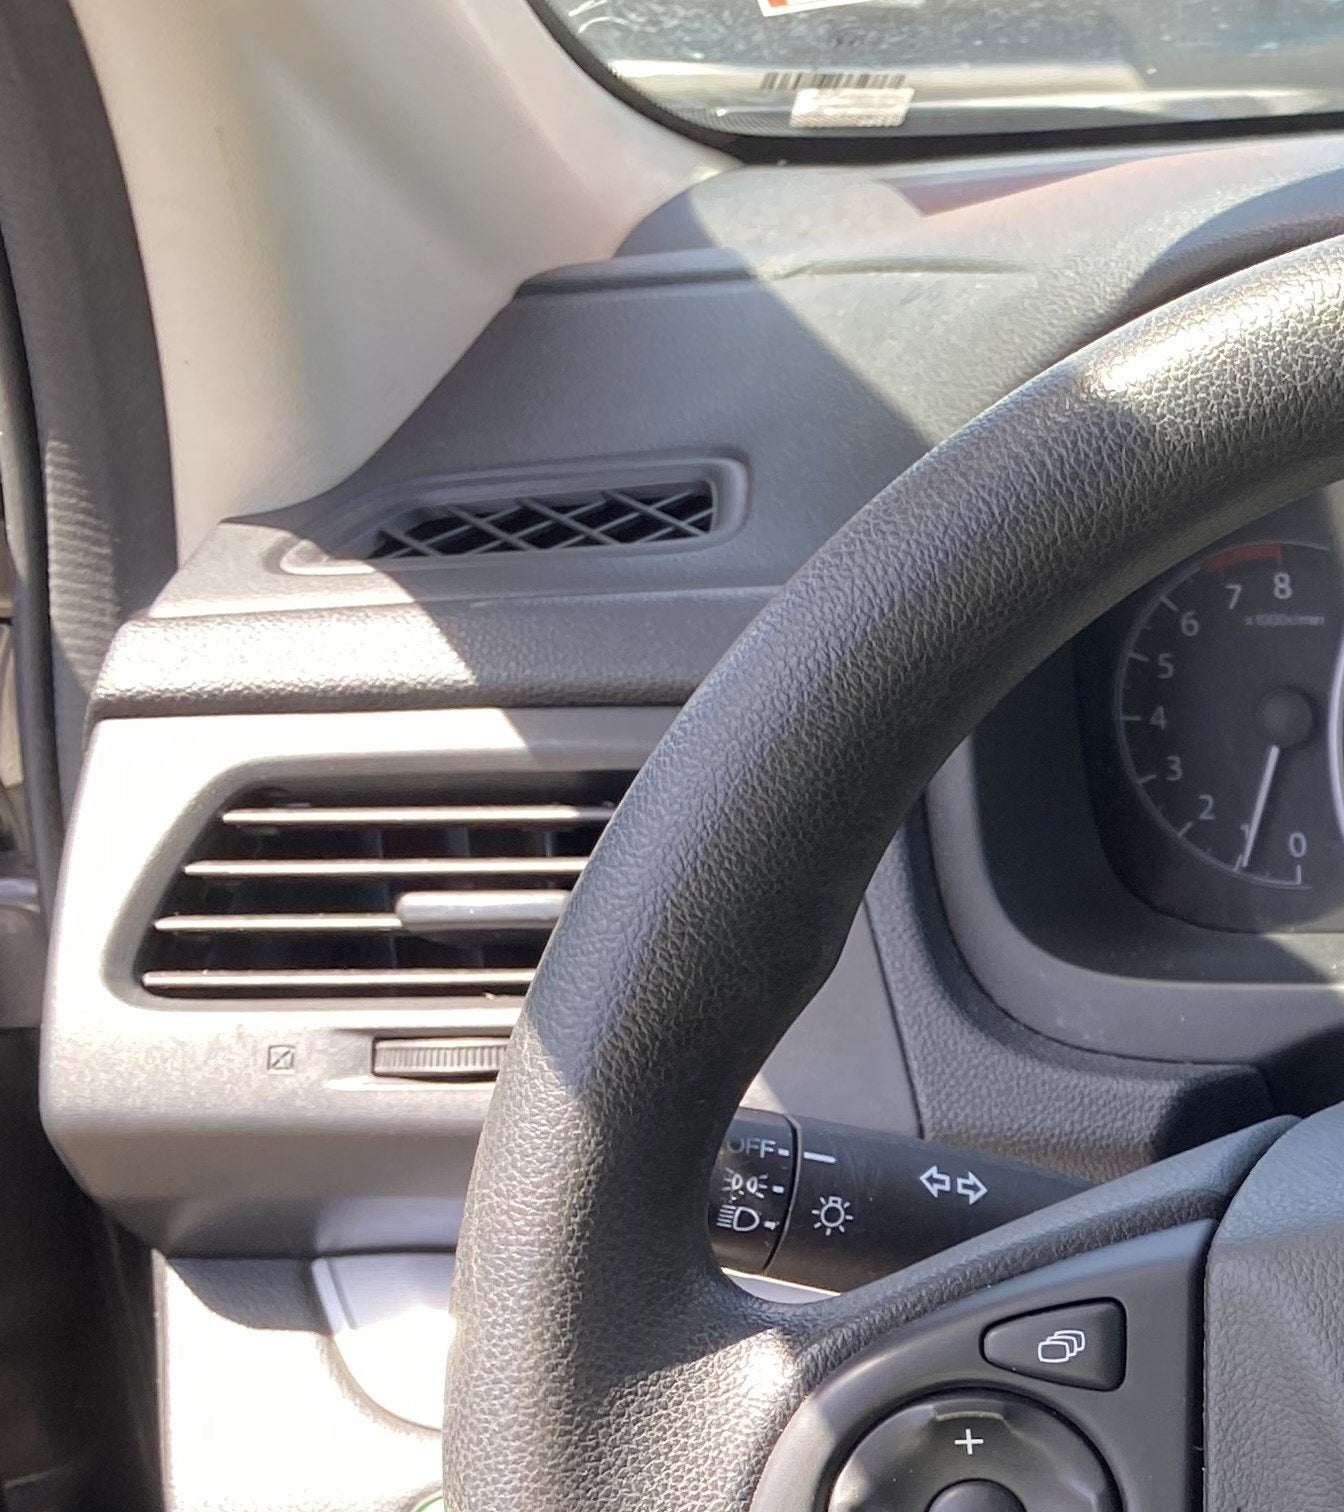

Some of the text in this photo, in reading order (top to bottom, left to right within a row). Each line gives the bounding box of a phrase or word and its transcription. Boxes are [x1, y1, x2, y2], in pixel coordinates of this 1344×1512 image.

[1225, 584, 1242, 610] 7
[1273, 572, 1292, 600] 8
[1180, 611, 1200, 636] 6
[1157, 653, 1174, 679] 5
[1150, 706, 1167, 730] 4
[1166, 755, 1183, 781] 3
[1198, 795, 1216, 820] 2
[1288, 832, 1308, 858] 0
[726, 1136, 777, 1158] OFF
